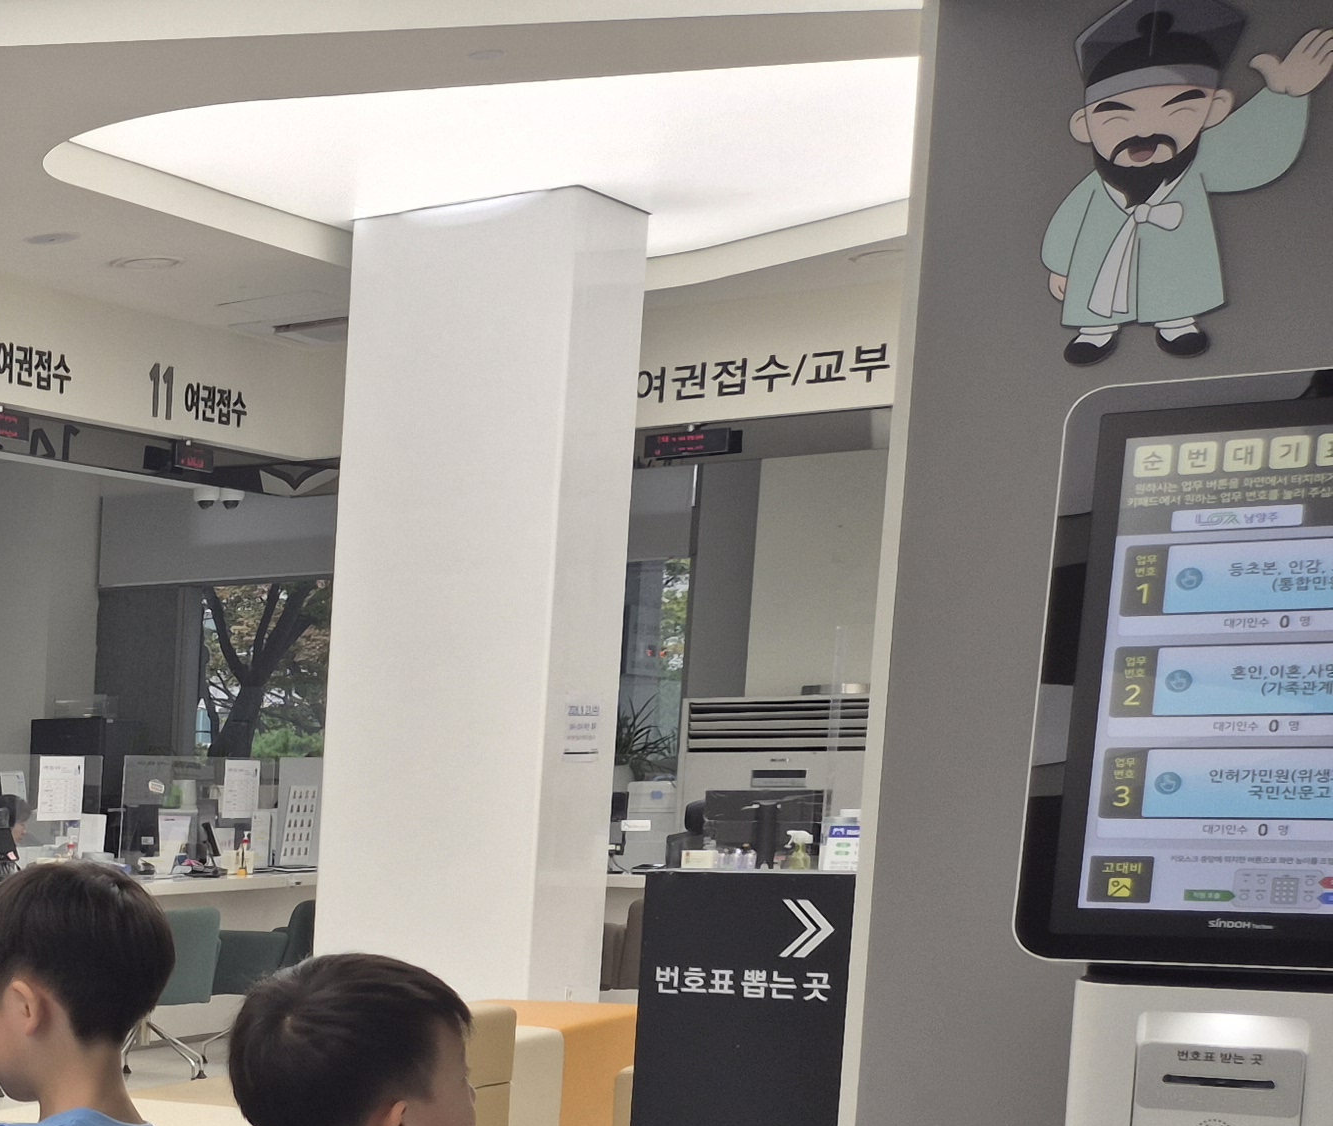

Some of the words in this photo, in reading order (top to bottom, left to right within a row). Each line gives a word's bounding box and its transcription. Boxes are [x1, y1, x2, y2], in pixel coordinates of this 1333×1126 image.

[637, 343, 890, 403] 여권접수/교부
[149, 362, 174, 420] 11
[184, 382, 247, 428] 여권접수
[1135, 482, 1177, 495] 원하시는
[1181, 480, 1203, 492] 업무
[1206, 478, 1239, 490] 버튼을
[1243, 476, 1289, 488] 화면에서
[1184, 493, 1217, 505] 원하는
[1220, 491, 1243, 502] 업무
[1245, 489, 1279, 501] 번호를
[1308, 485, 1333, 497] 주십
[1244, 512, 1279, 524] 남양주
[1136, 555, 1157, 565] 업무
[1135, 567, 1156, 577] 번호
[1228, 561, 1281, 576] 등초본,
[1288, 560, 1325, 575] 인감,
[1136, 583, 1150, 604] 1
[1223, 617, 1270, 628] 대기인수
[1279, 615, 1290, 628] 0
[1299, 616, 1311, 627] 명
[1125, 657, 1146, 666] 업무
[1124, 668, 1146, 679] 번호
[1123, 684, 1141, 706] 2
[1261, 682, 1333, 697] (가족관계
[1213, 721, 1259, 732] 대기인수
[1268, 719, 1279, 733] 0
[1288, 721, 1300, 732] 명
[1115, 758, 1136, 768] 업무
[1114, 769, 1135, 780] 번호
[1209, 769, 1333, 784] 인허가민원(위생
[1112, 786, 1130, 807] 3
[1202, 824, 1249, 835] 대기인수
[1258, 823, 1268, 836] 0
[1278, 824, 1289, 836] 명
[1102, 862, 1142, 874] 고대비
[655, 966, 736, 995] 번호표
[741, 969, 797, 1000] 뽑는
[802, 971, 831, 1002] 곳
[1177, 1050, 1215, 1062] 번호표
[1220, 1052, 1245, 1065] 받는
[1251, 1053, 1264, 1065] 곳
